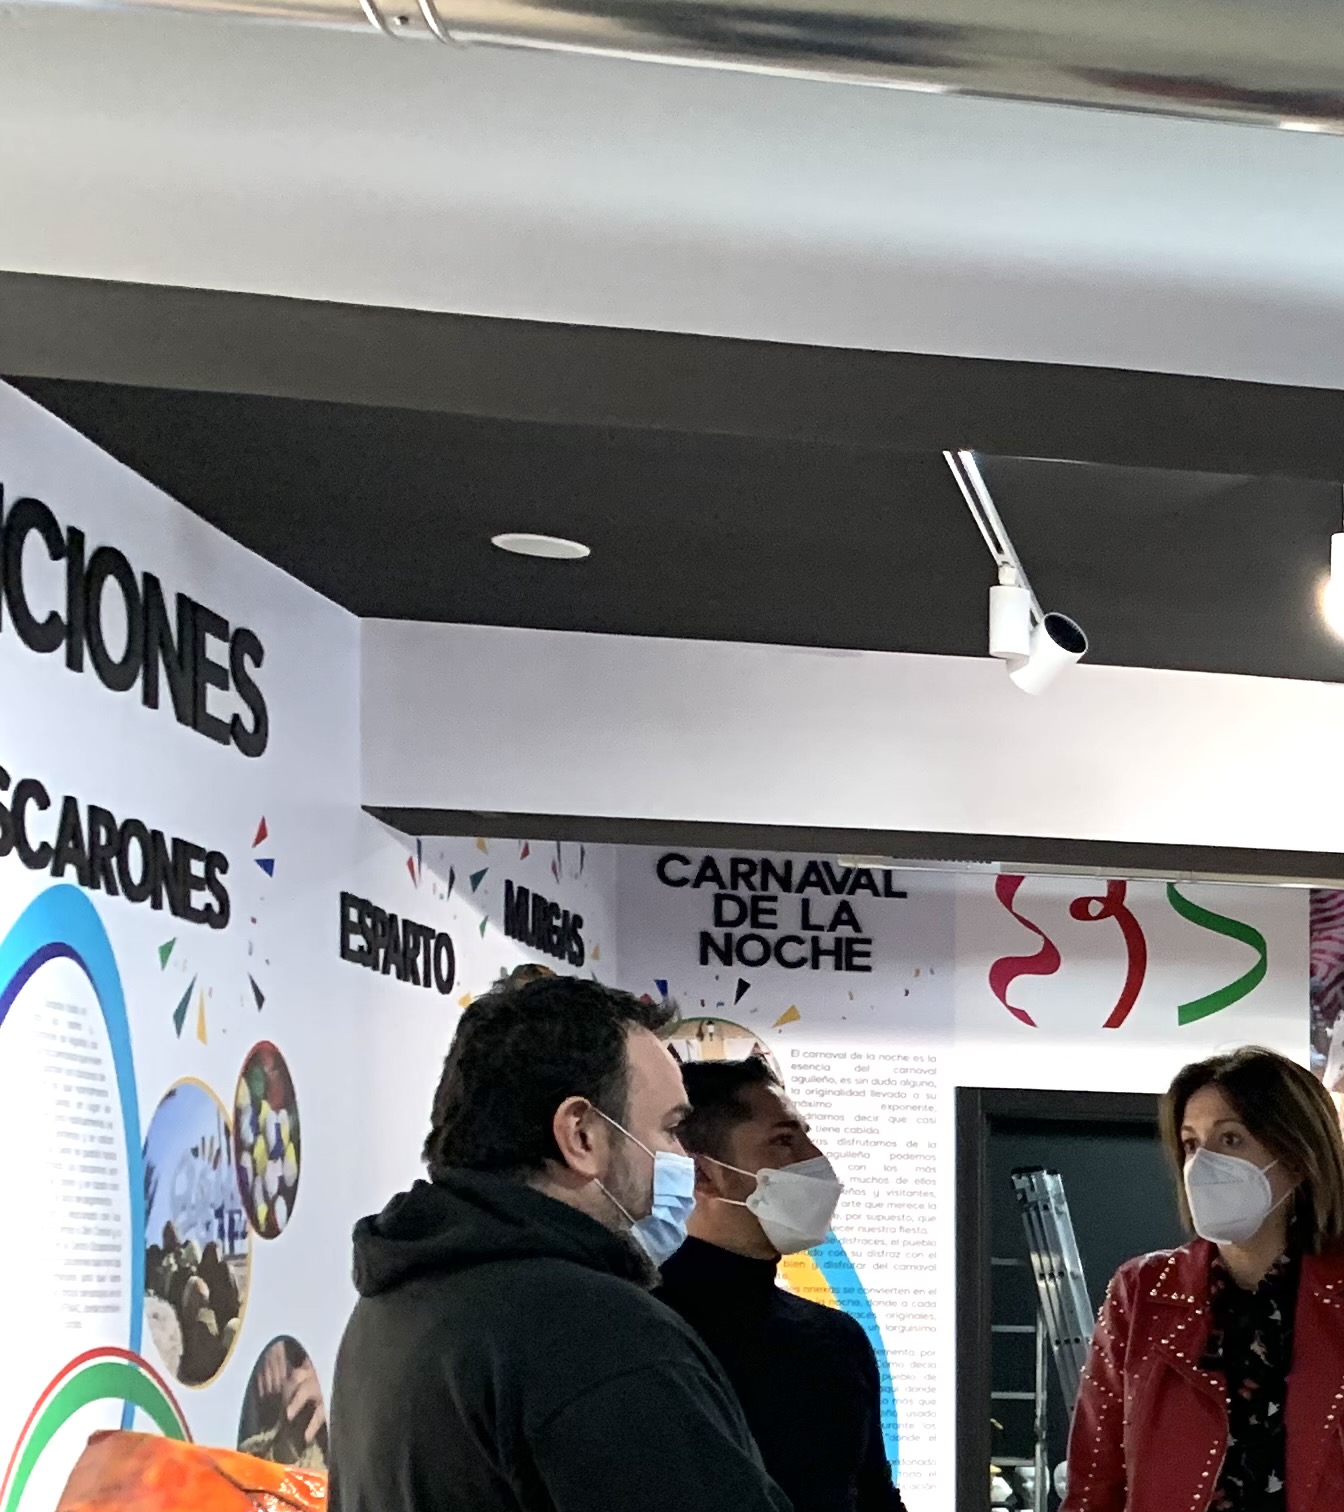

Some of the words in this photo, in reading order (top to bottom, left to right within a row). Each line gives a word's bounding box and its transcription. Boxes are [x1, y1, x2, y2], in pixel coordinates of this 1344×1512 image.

[0, 482, 269, 757] CIONES
[656, 852, 908, 899] CARNAVAL
[713, 892, 778, 930] DE
[801, 897, 862, 933] LA
[505, 879, 585, 967] MURGAS
[340, 891, 456, 995] ESPARTO
[700, 931, 872, 973] NOCHE
[803, 1050, 846, 1059] carnaval
[879, 1053, 909, 1061] noche
[791, 1063, 830, 1071] esencia
[805, 1088, 865, 1098] originalidad
[871, 1089, 906, 1098] llevada
[854, 1114, 879, 1122] decir
[888, 1116, 907, 1124] que
[917, 1116, 936, 1124] casi
[837, 1138, 897, 1147] disfrutamos
[890, 1153, 936, 1161] podemos
[884, 1164, 897, 1172] los
[850, 1176, 889, 1184] muchos
[865, 1202, 884, 1210] que
[846, 1213, 862, 1221] por
[903, 1239, 936, 1247] pueblo
[851, 1250, 862, 1258] su
[867, 1250, 900, 1258] disfraz
[906, 1251, 924, 1259] con
[928, 1251, 936, 1259] el
[928, 1287, 936, 1295] el
[912, 1300, 936, 1308] cada
